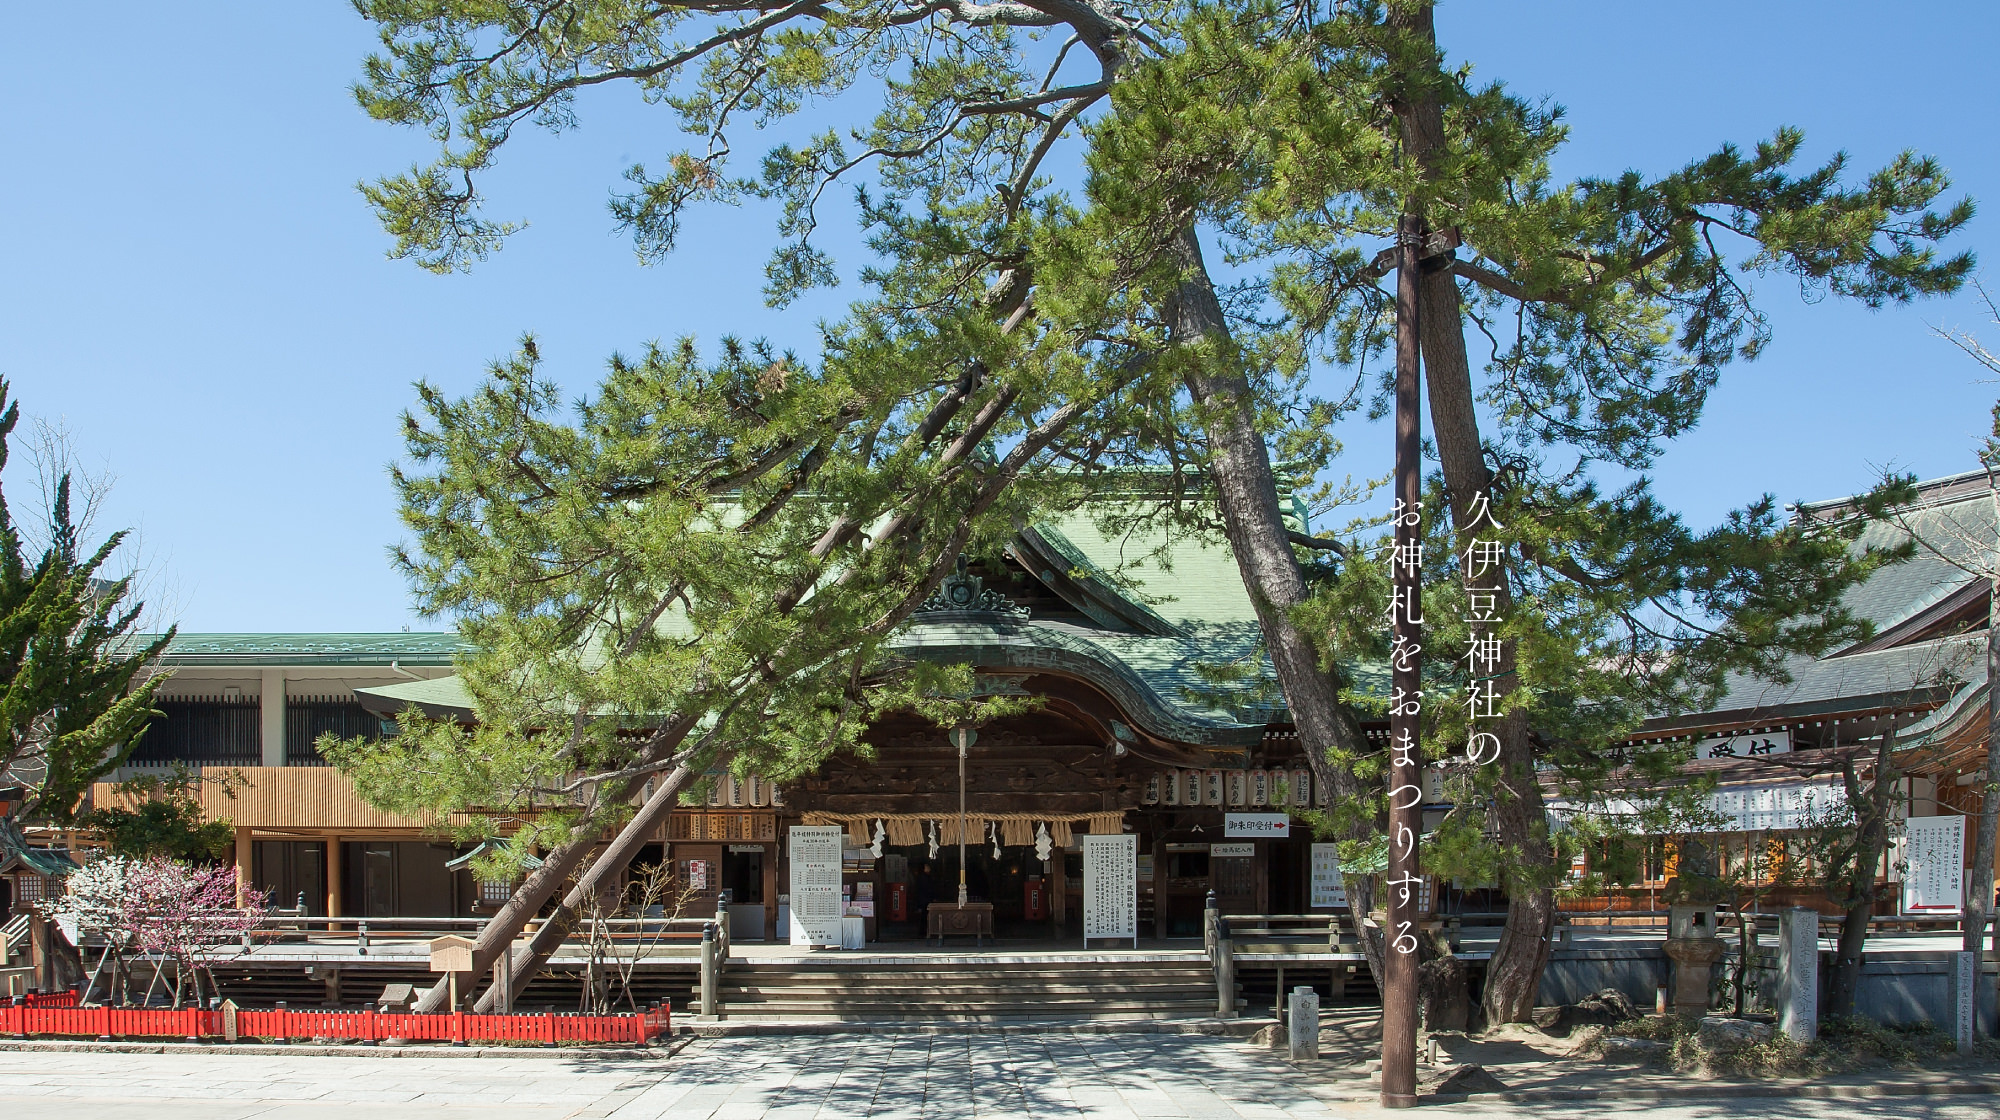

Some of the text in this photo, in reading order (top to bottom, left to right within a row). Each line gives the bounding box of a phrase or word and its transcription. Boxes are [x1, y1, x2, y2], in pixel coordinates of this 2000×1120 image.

[1228, 820, 1273, 831] 御朱印受付
[1299, 999, 1311, 1049] 白山神社
